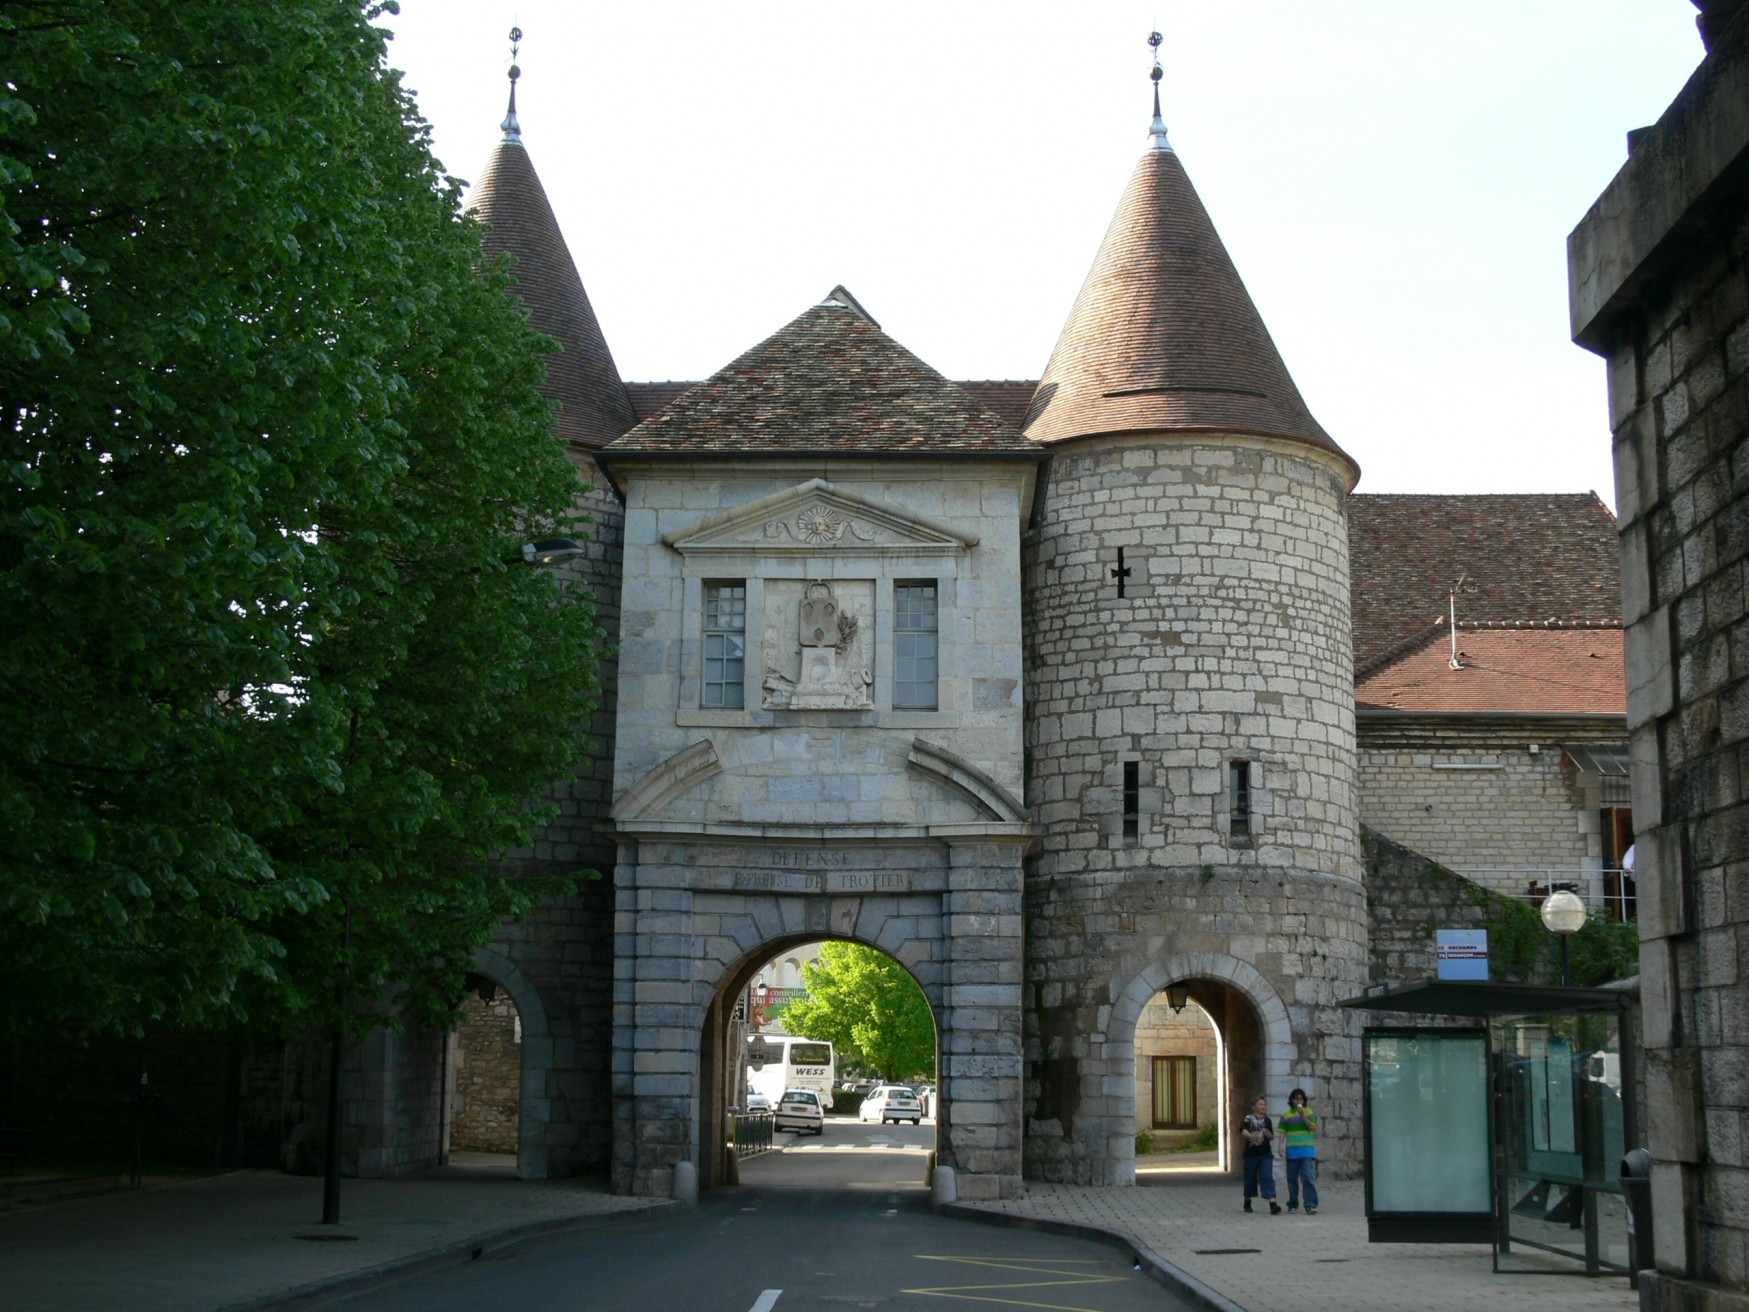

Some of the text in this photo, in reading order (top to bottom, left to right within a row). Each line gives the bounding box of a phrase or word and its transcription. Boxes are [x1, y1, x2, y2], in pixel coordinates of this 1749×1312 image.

[772, 851, 850, 866] DEFENSE
[750, 996, 766, 1007] qui
[796, 1067, 825, 1076] WESS
